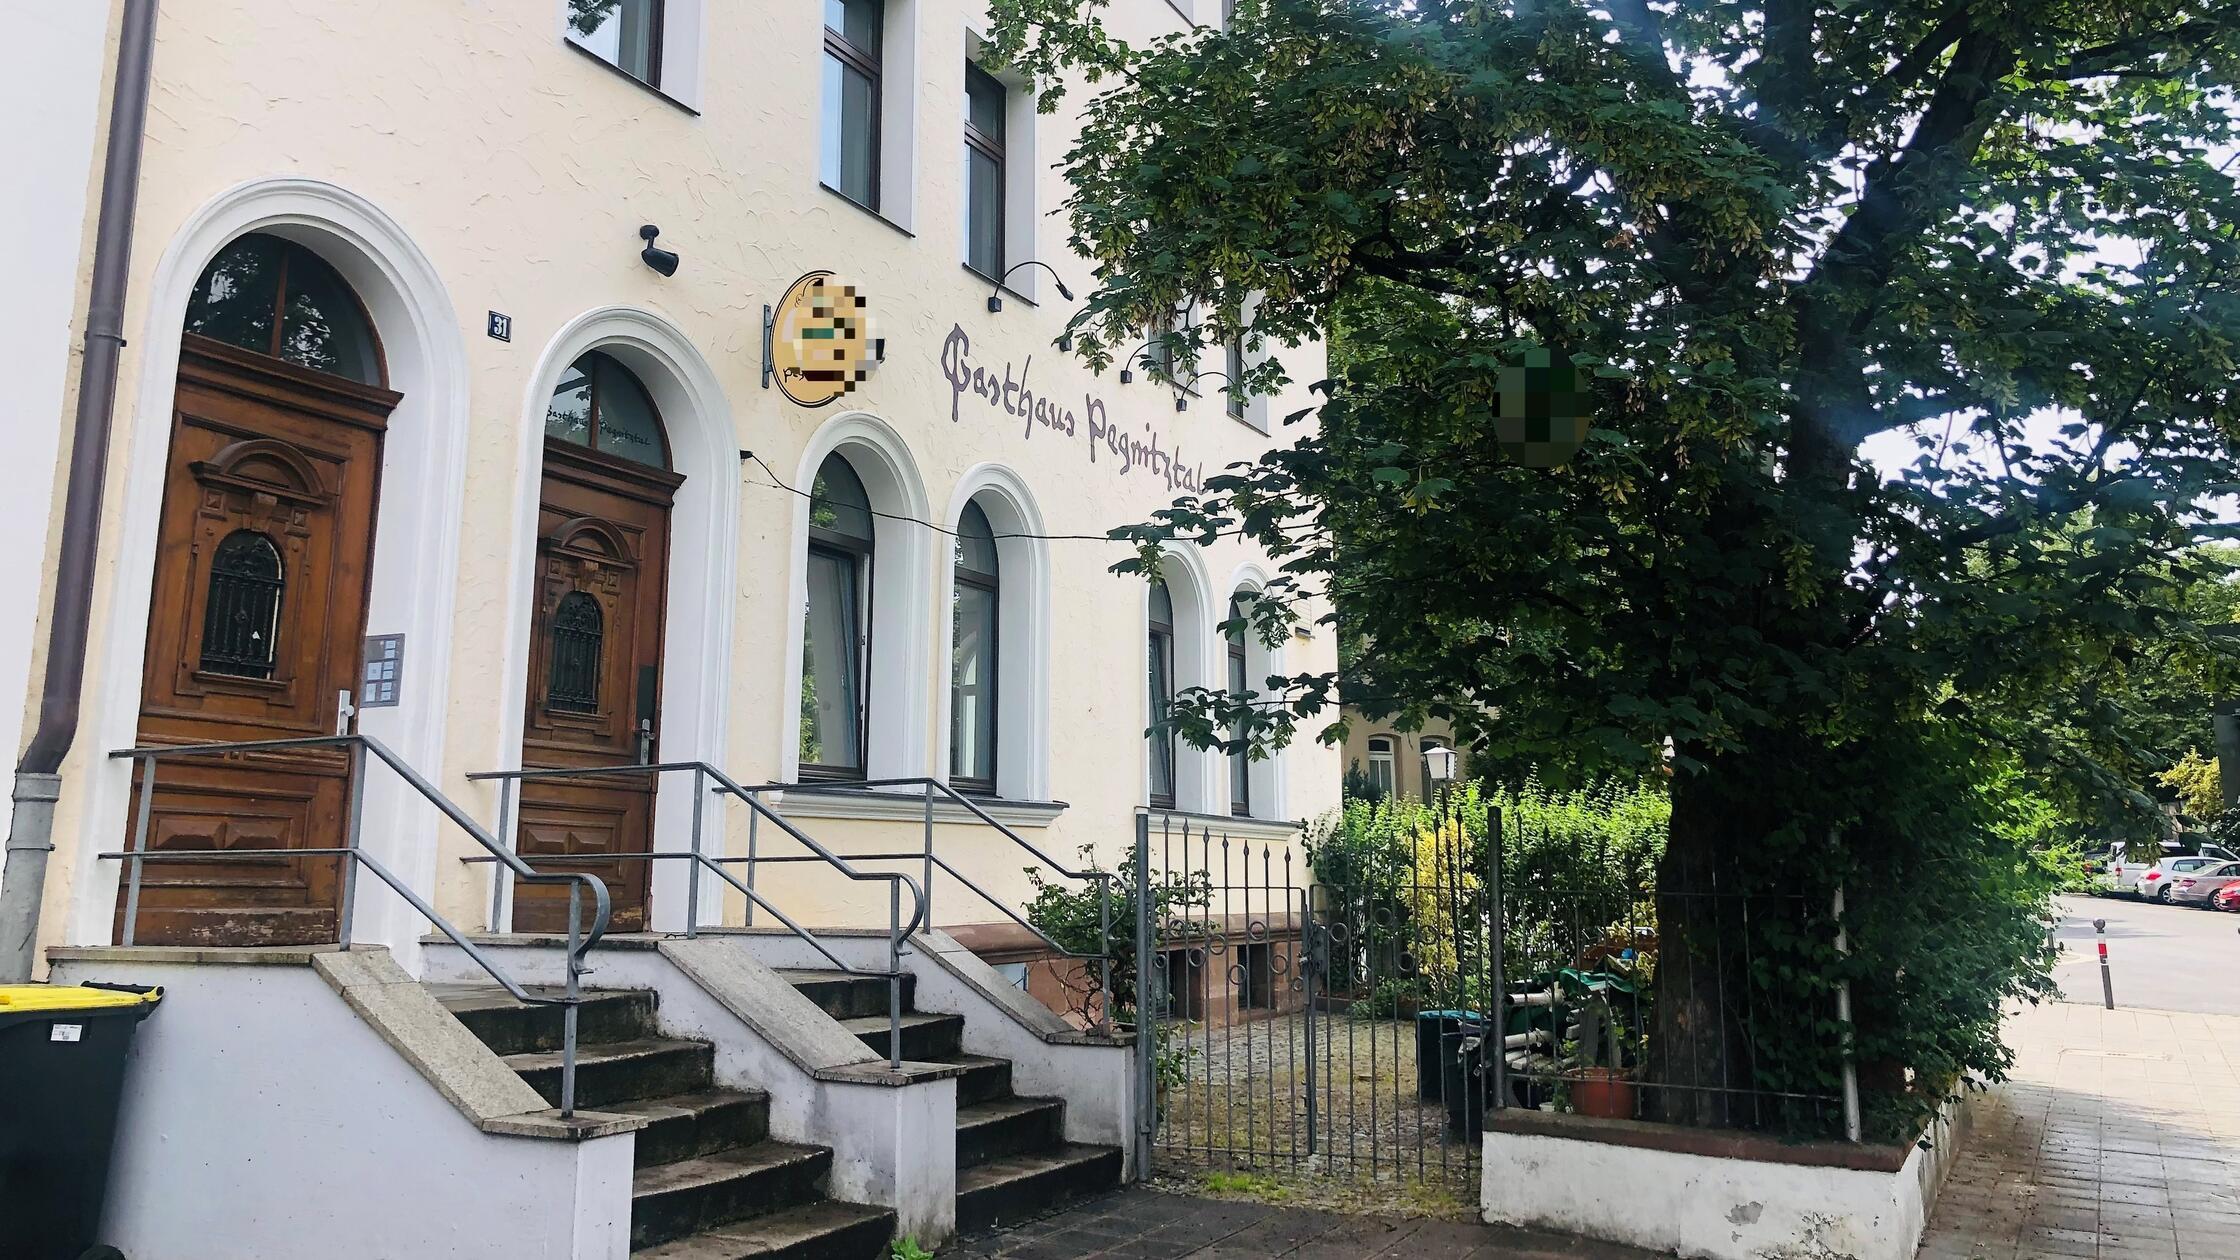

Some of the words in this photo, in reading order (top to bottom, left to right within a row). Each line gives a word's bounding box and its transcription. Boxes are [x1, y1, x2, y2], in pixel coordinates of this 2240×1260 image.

[493, 316, 507, 337] 31
[941, 323, 1075, 439] Gasthaus
[1086, 393, 1208, 495] Pegnitztal
